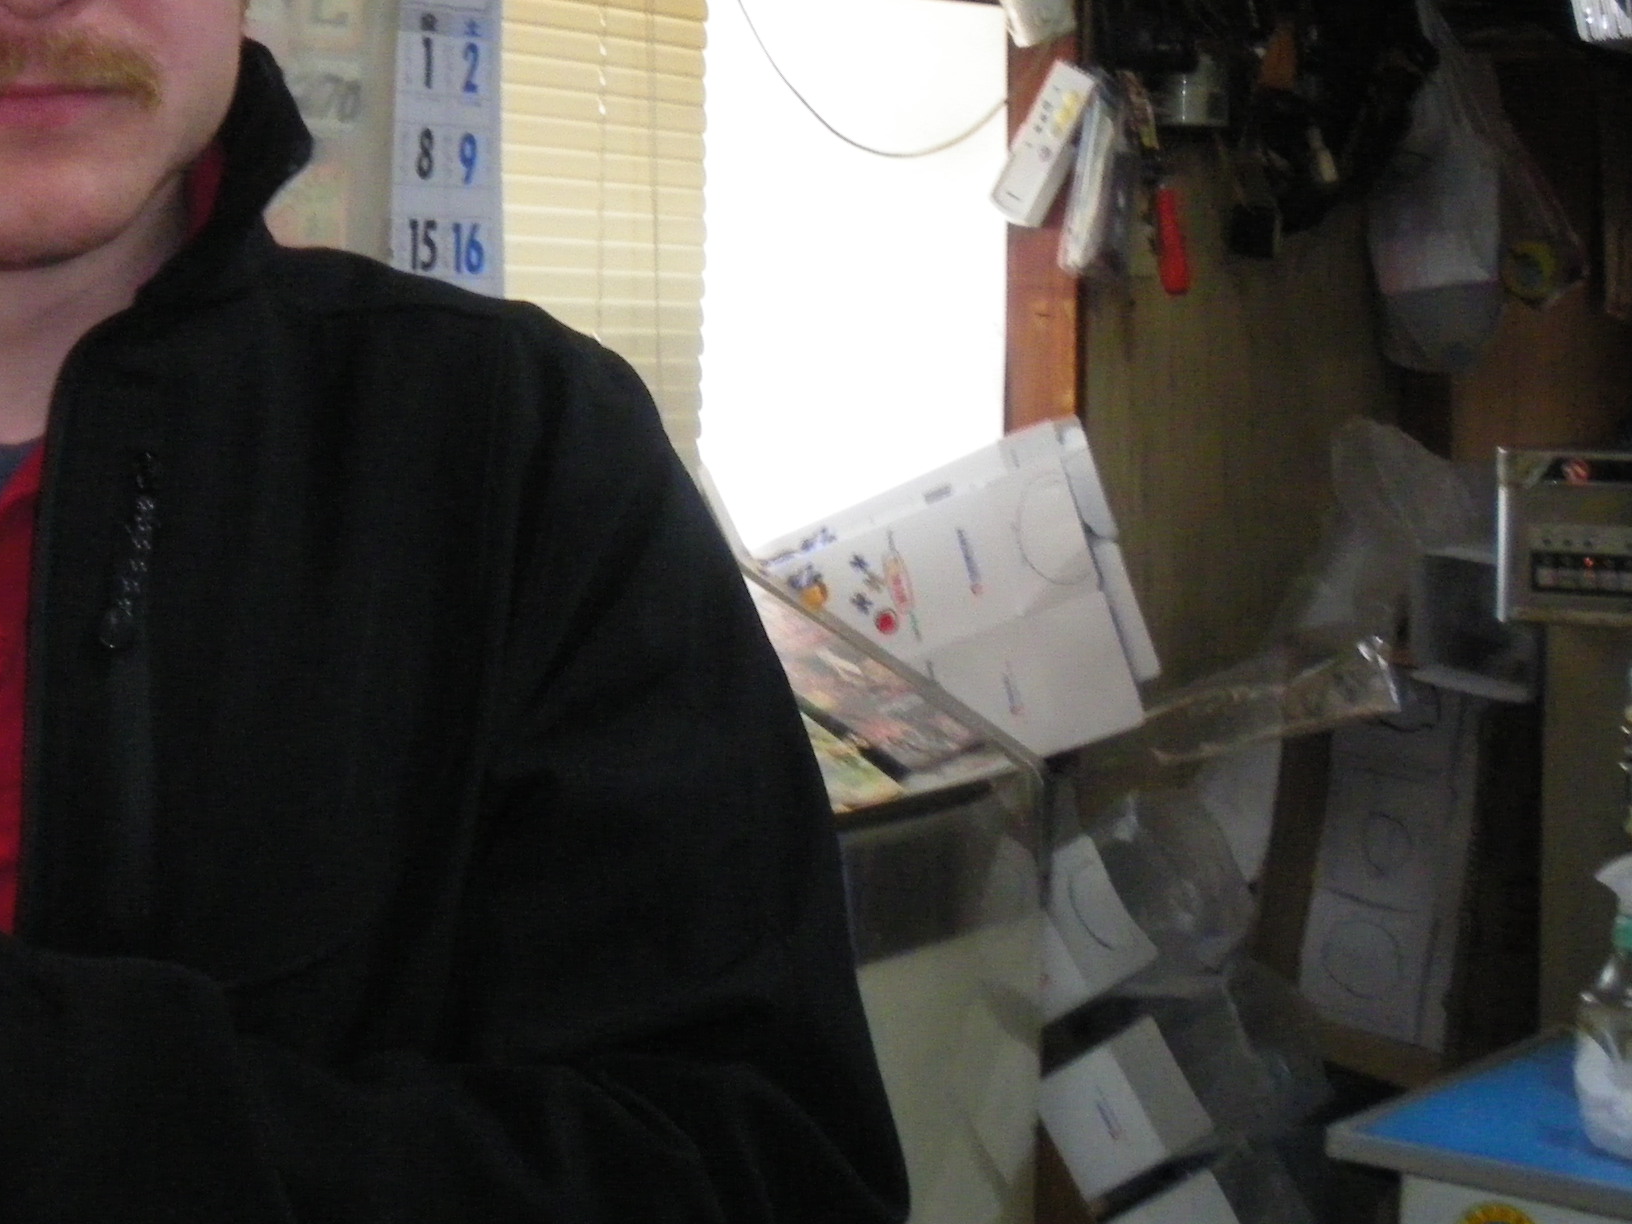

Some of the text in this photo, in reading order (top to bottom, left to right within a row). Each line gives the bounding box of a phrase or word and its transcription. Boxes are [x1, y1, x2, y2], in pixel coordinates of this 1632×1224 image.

[422, 37, 479, 93] 1 2
[415, 127, 477, 184] 8 9
[409, 219, 484, 275] 15 16
